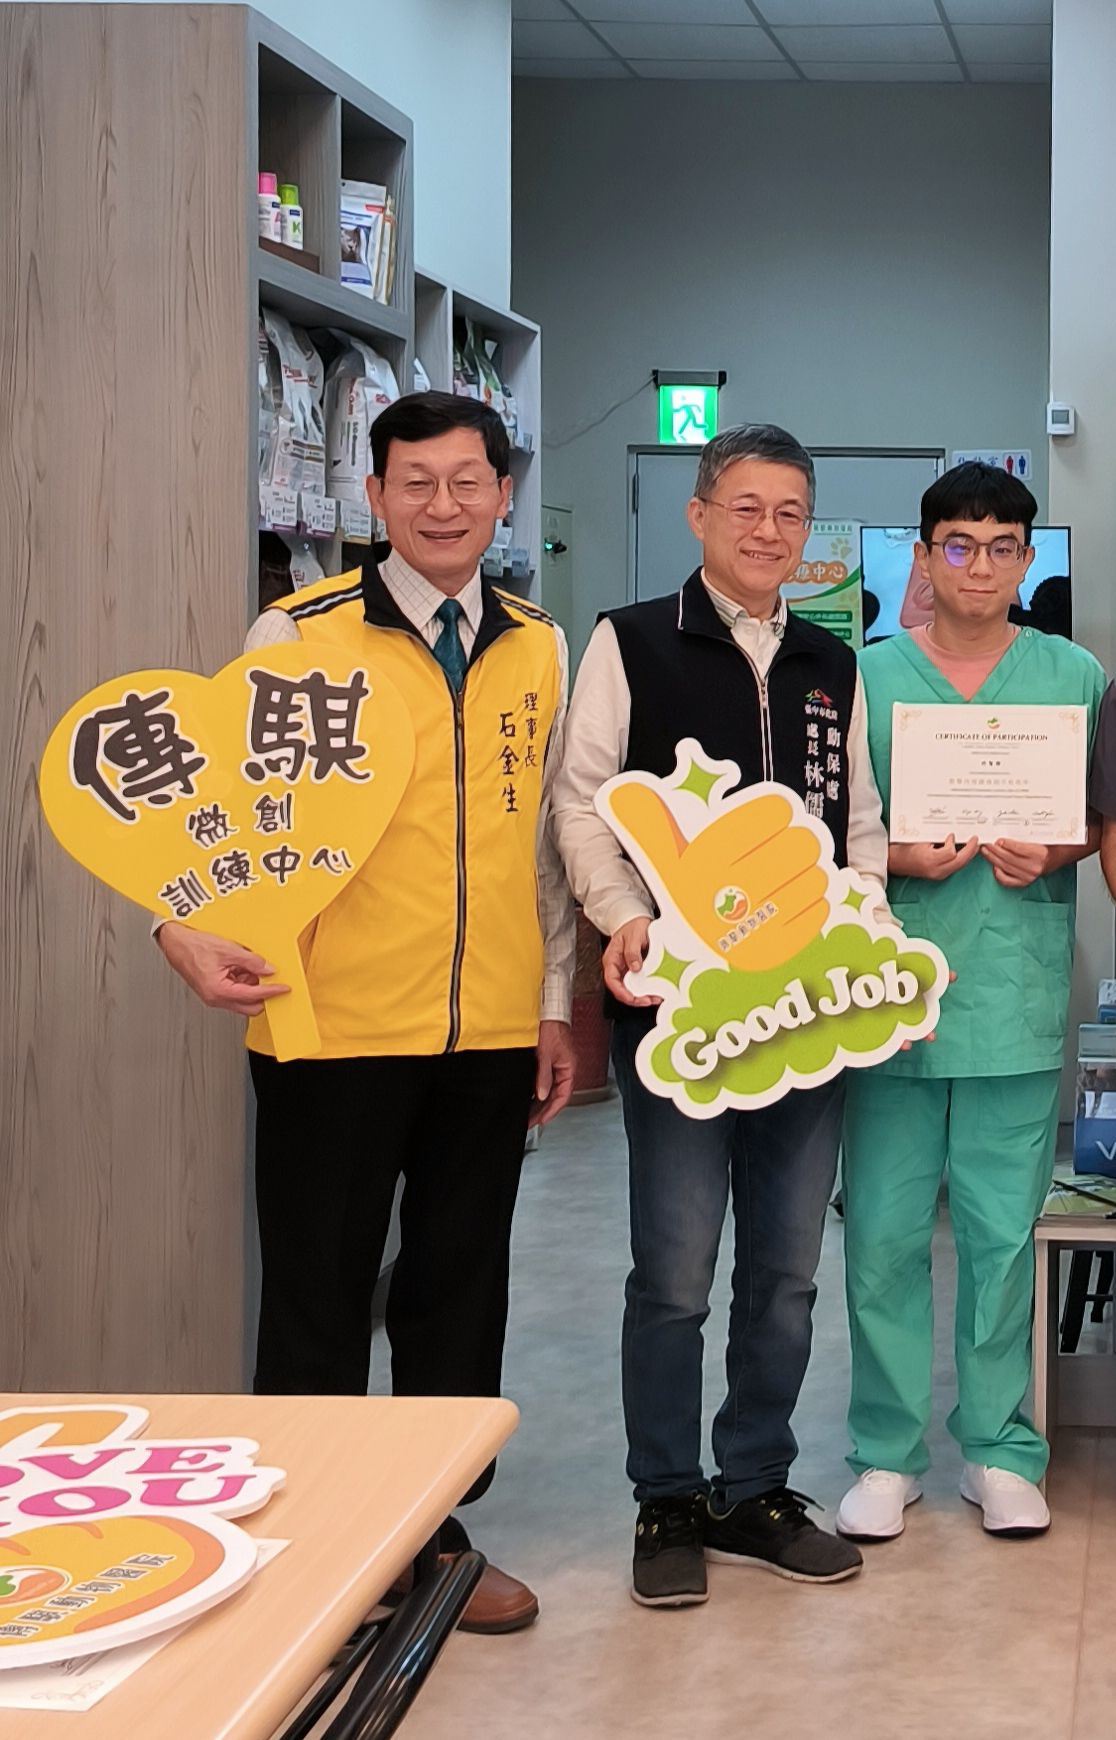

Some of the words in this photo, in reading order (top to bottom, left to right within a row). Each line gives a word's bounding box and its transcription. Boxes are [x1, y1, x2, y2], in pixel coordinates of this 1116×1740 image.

[498, 711, 520, 813] 石金生
[524, 692, 539, 768] 理事長
[935, 732, 980, 741] CERTIFICATE
[981, 733, 991, 741] OF
[992, 733, 1048, 742] PARTICIPATION
[188, 794, 293, 847] 微創
[160, 846, 352, 917] 訓練中心
[670, 978, 816, 1080] Good
[818, 960, 918, 1015] Job
[0, 1475, 257, 1527] OU
